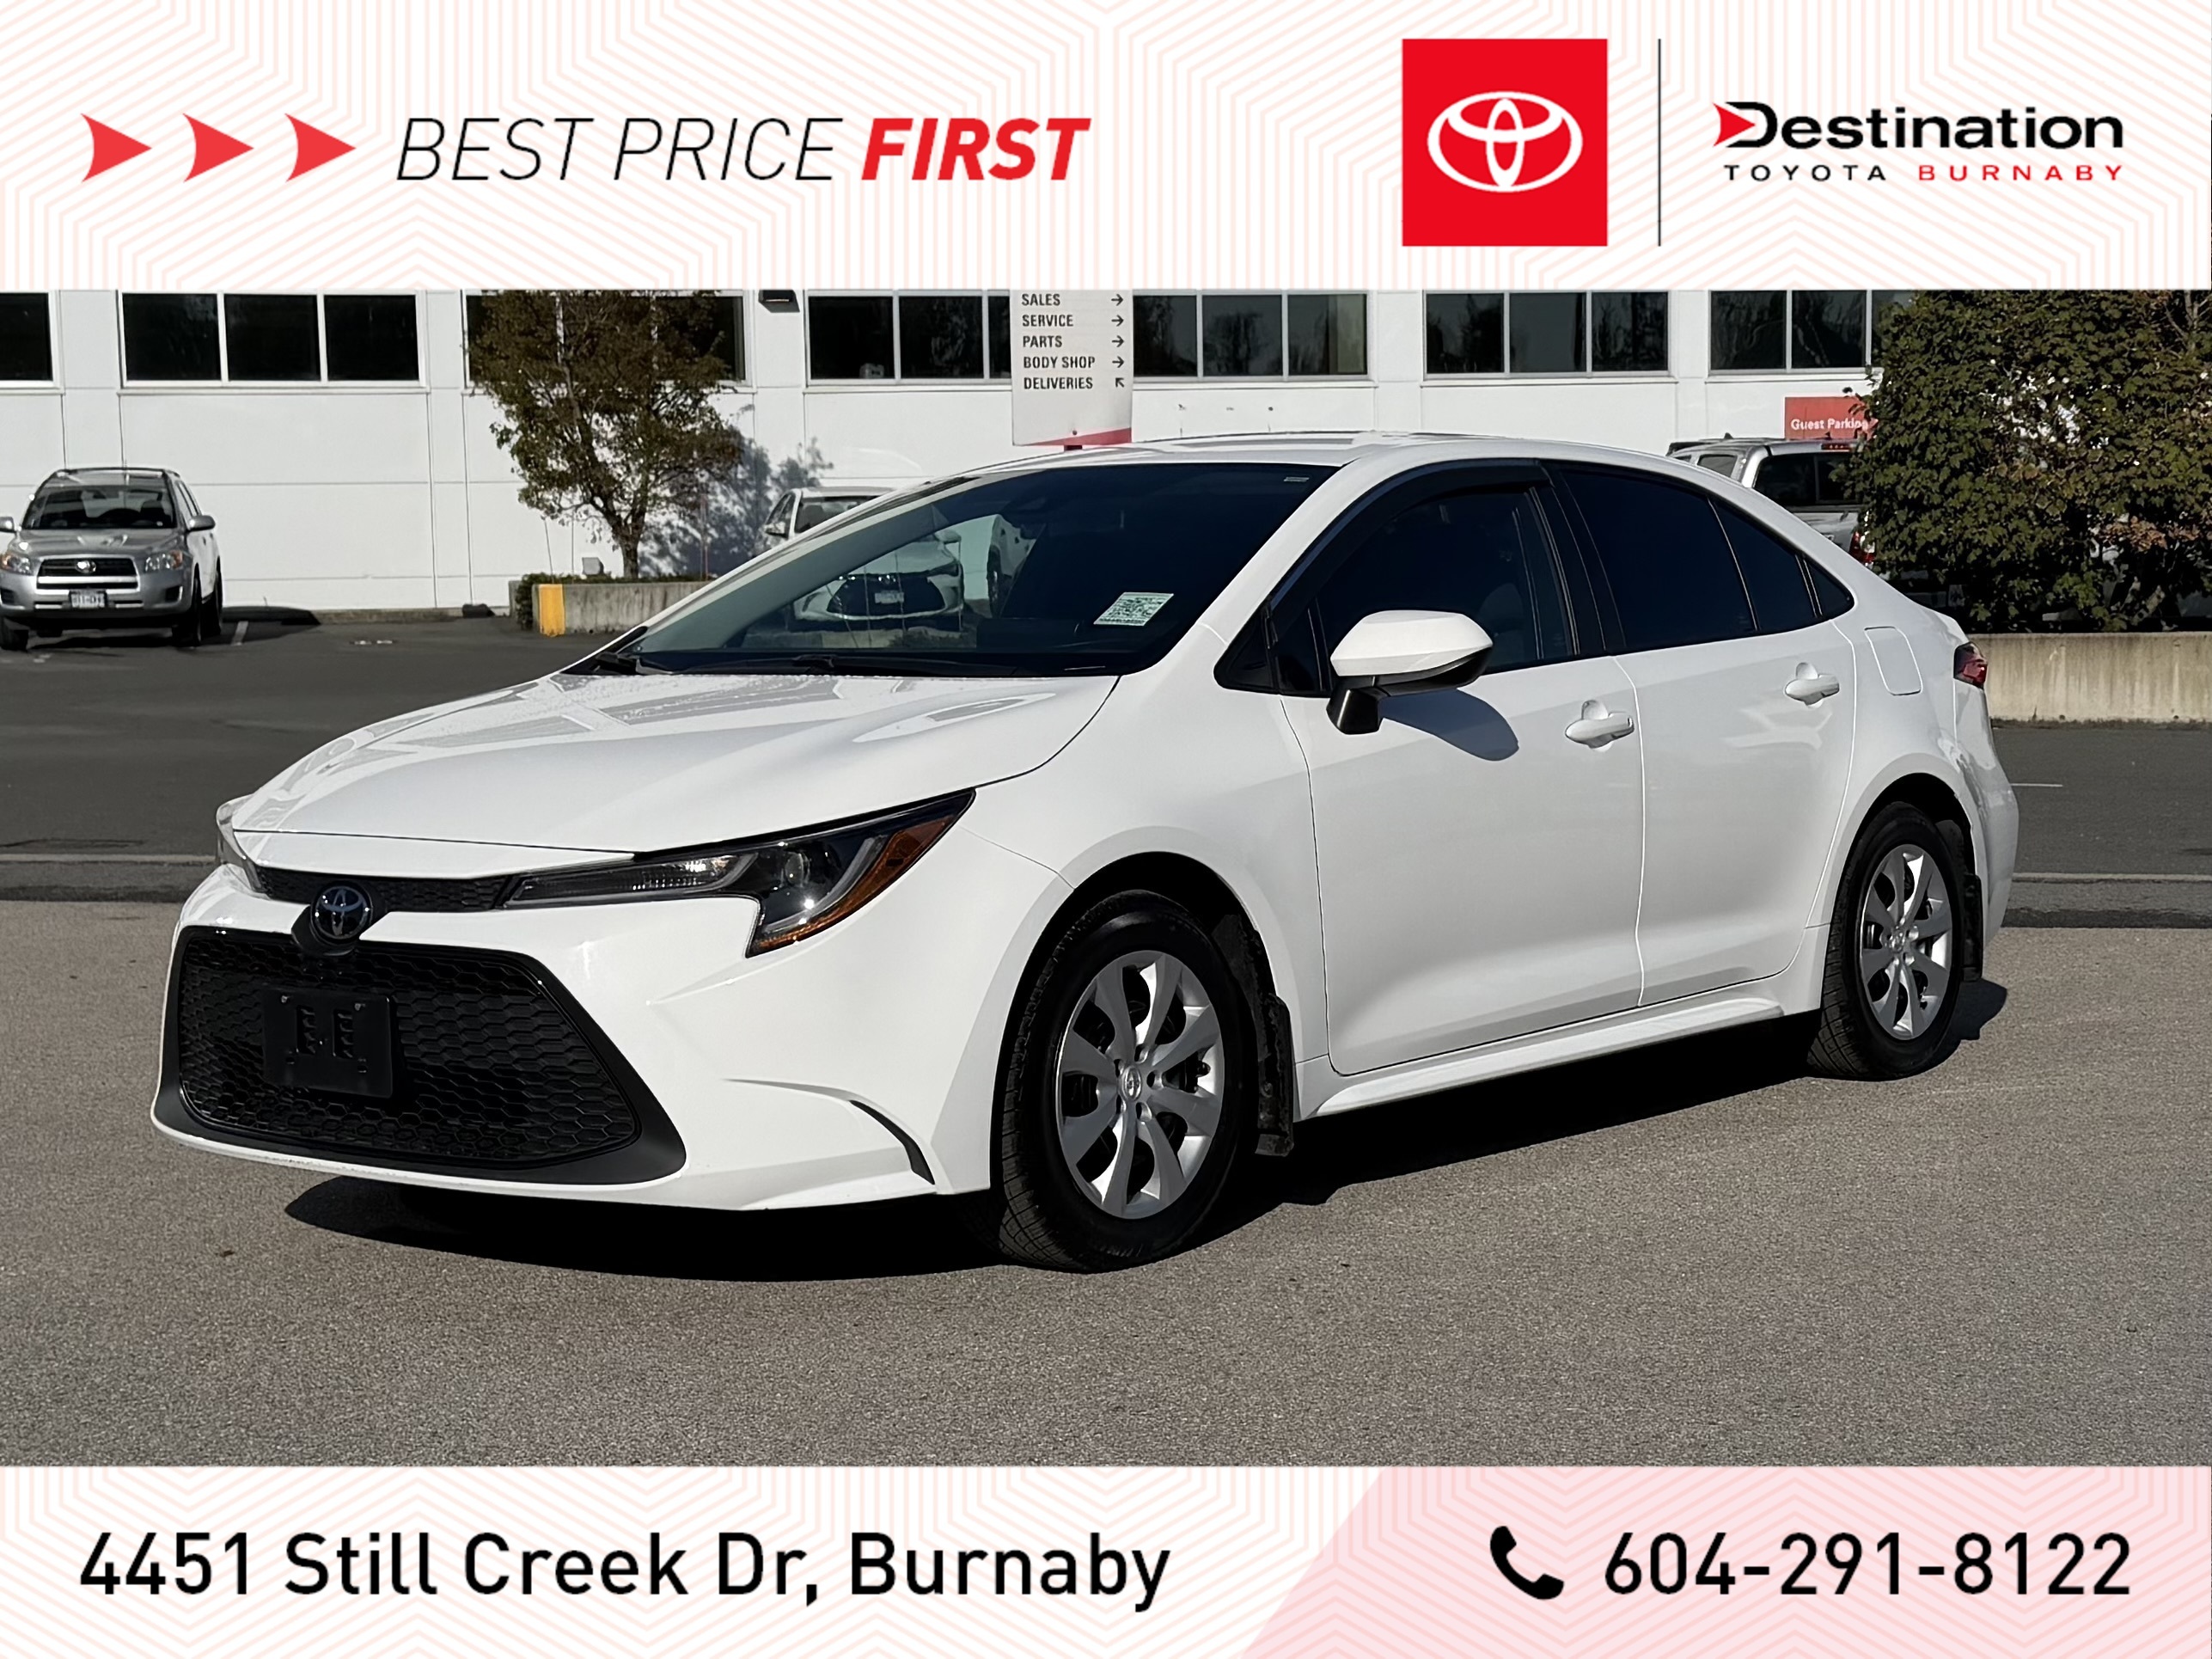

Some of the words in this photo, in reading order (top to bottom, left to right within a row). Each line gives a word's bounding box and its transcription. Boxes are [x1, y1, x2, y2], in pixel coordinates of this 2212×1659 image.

[1022, 293, 1060, 306] SALES
[1022, 314, 1074, 327] SERVICE
[1023, 335, 1063, 348] PARTS
[1024, 356, 1058, 369] BODY
[1061, 356, 1096, 369] SHOP
[1024, 376, 1093, 389] DELIVERIES
[1790, 419, 1824, 431] Guest
